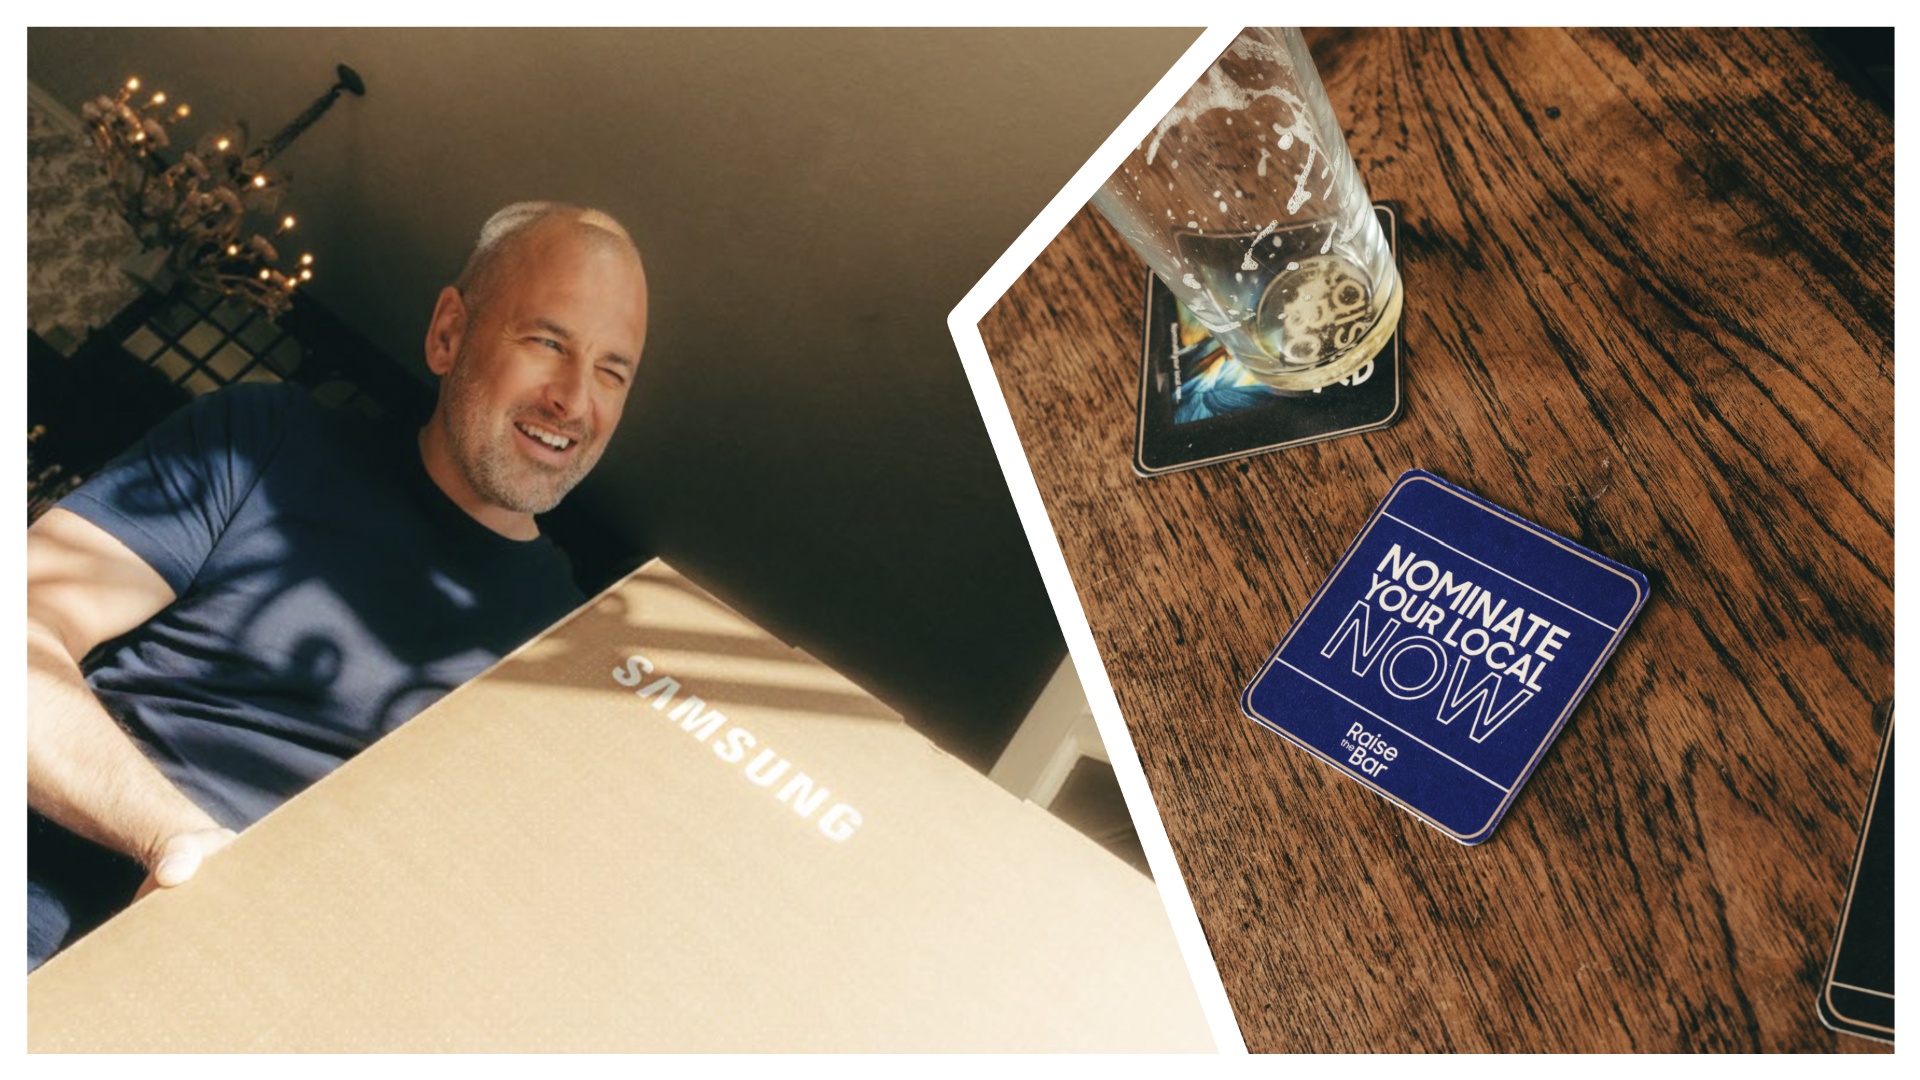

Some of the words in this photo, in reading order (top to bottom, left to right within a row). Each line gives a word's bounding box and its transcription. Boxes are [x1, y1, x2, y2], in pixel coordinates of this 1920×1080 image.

[1364, 573, 1445, 635] YOUR
[1443, 618, 1546, 692] LOCAL
[1376, 543, 1571, 661] NOMINATE
[1320, 600, 1534, 744] NOW
[612, 655, 863, 842] SAMSUNG
[1340, 739, 1355, 751] the
[1348, 746, 1388, 777] Bar
[1346, 721, 1398, 761] Raise
